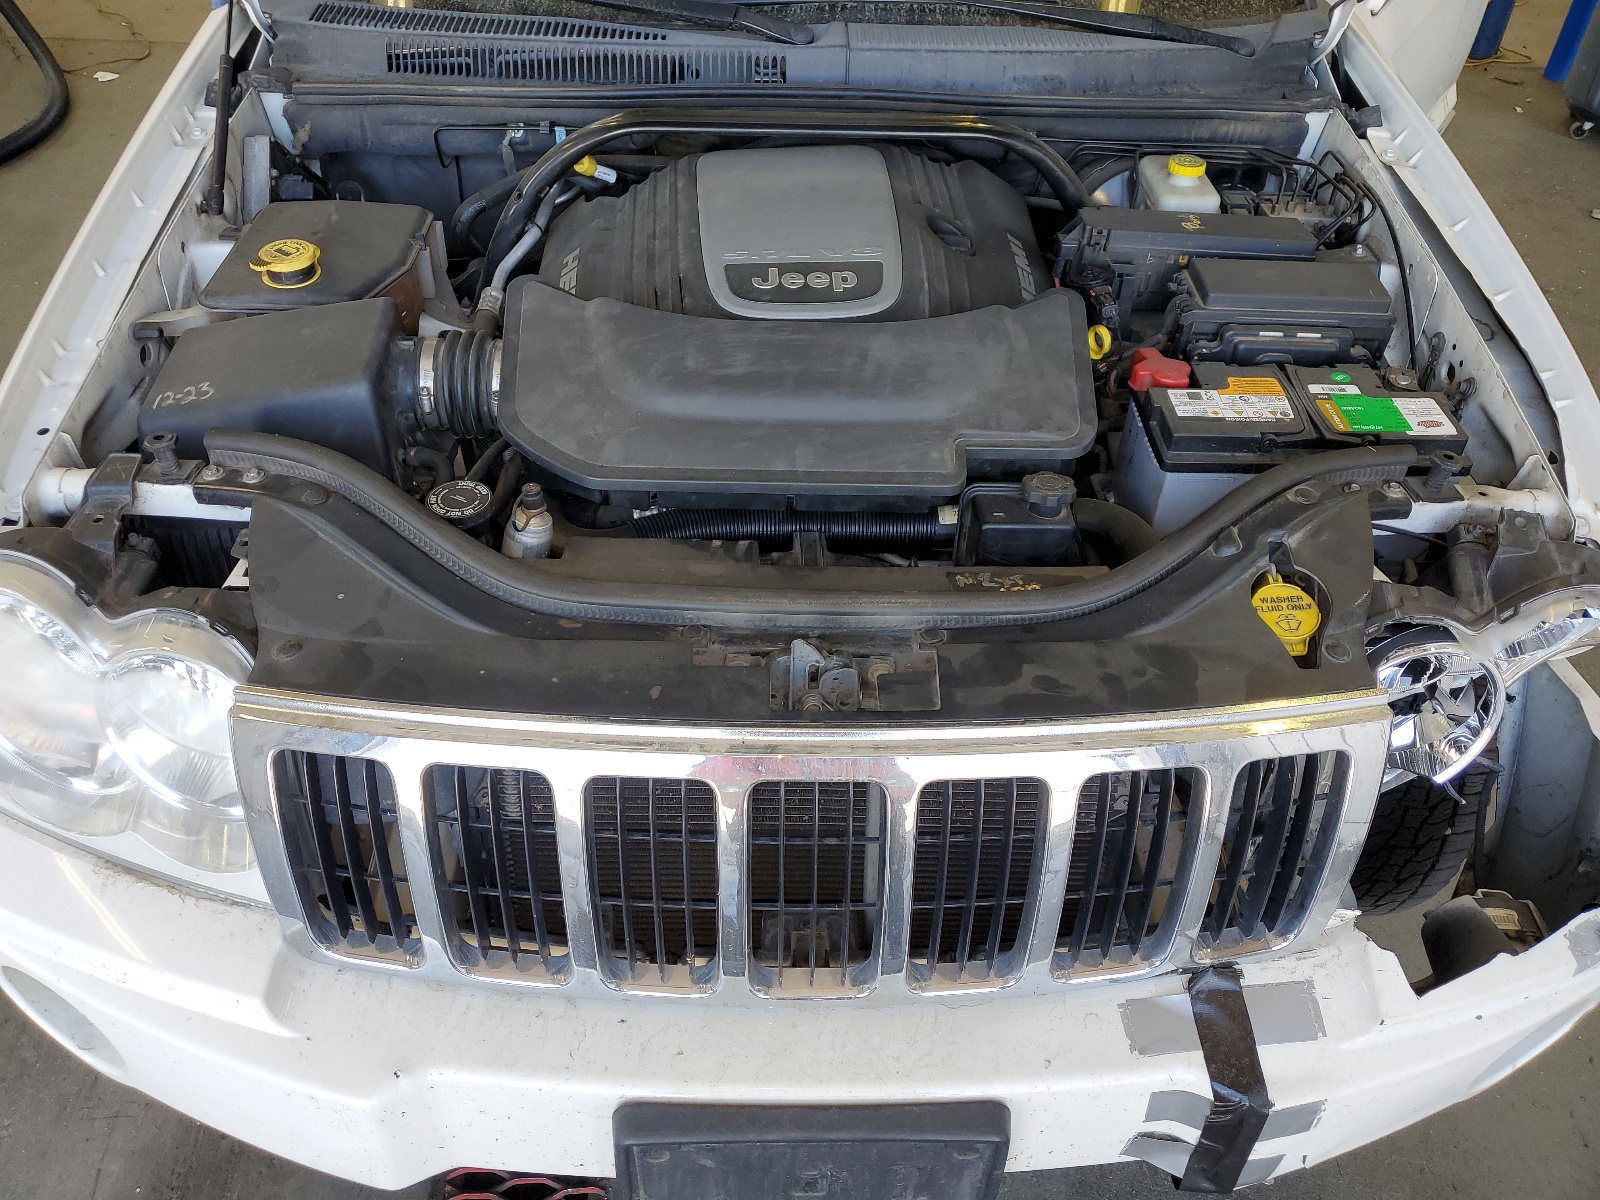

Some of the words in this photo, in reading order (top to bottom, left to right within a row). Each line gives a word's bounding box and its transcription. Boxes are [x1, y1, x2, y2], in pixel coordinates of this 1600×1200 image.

[751, 267, 858, 292] Jeep
[152, 381, 215, 410] 12-23
[1255, 604, 1284, 613] FLUID
[1287, 602, 1312, 611] ONLY
[1259, 596, 1304, 604] WASHER
